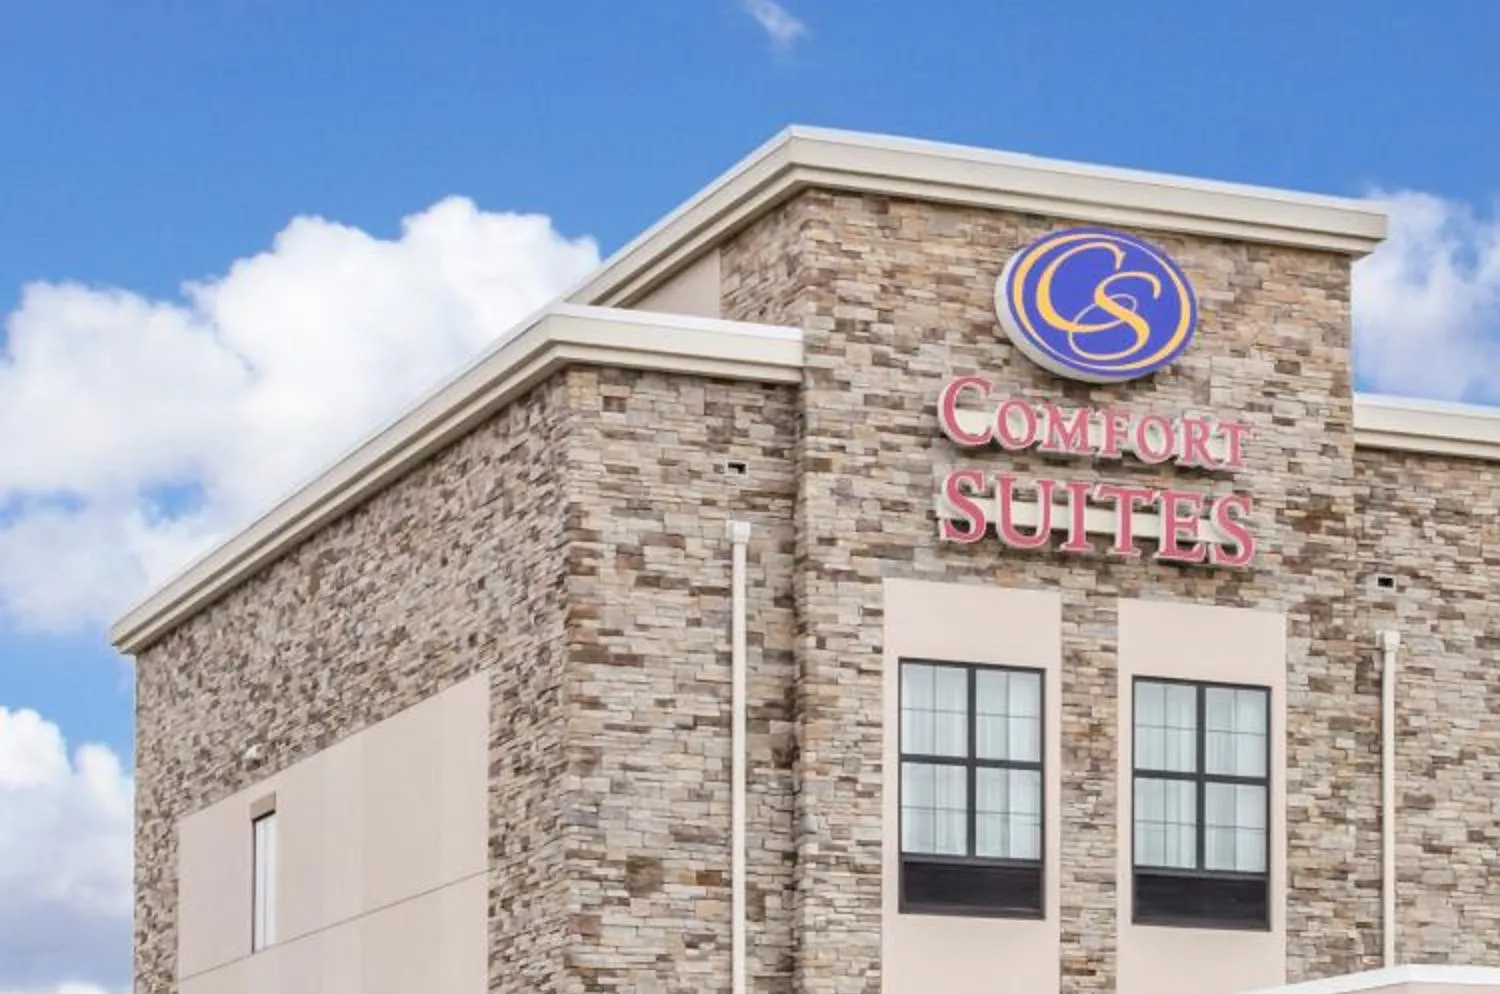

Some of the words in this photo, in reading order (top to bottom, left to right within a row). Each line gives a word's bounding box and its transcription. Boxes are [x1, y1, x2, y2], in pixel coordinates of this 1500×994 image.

[1035, 241, 1161, 361] CS
[938, 375, 1252, 471] COMFORT
[938, 468, 1257, 568] SUITES
